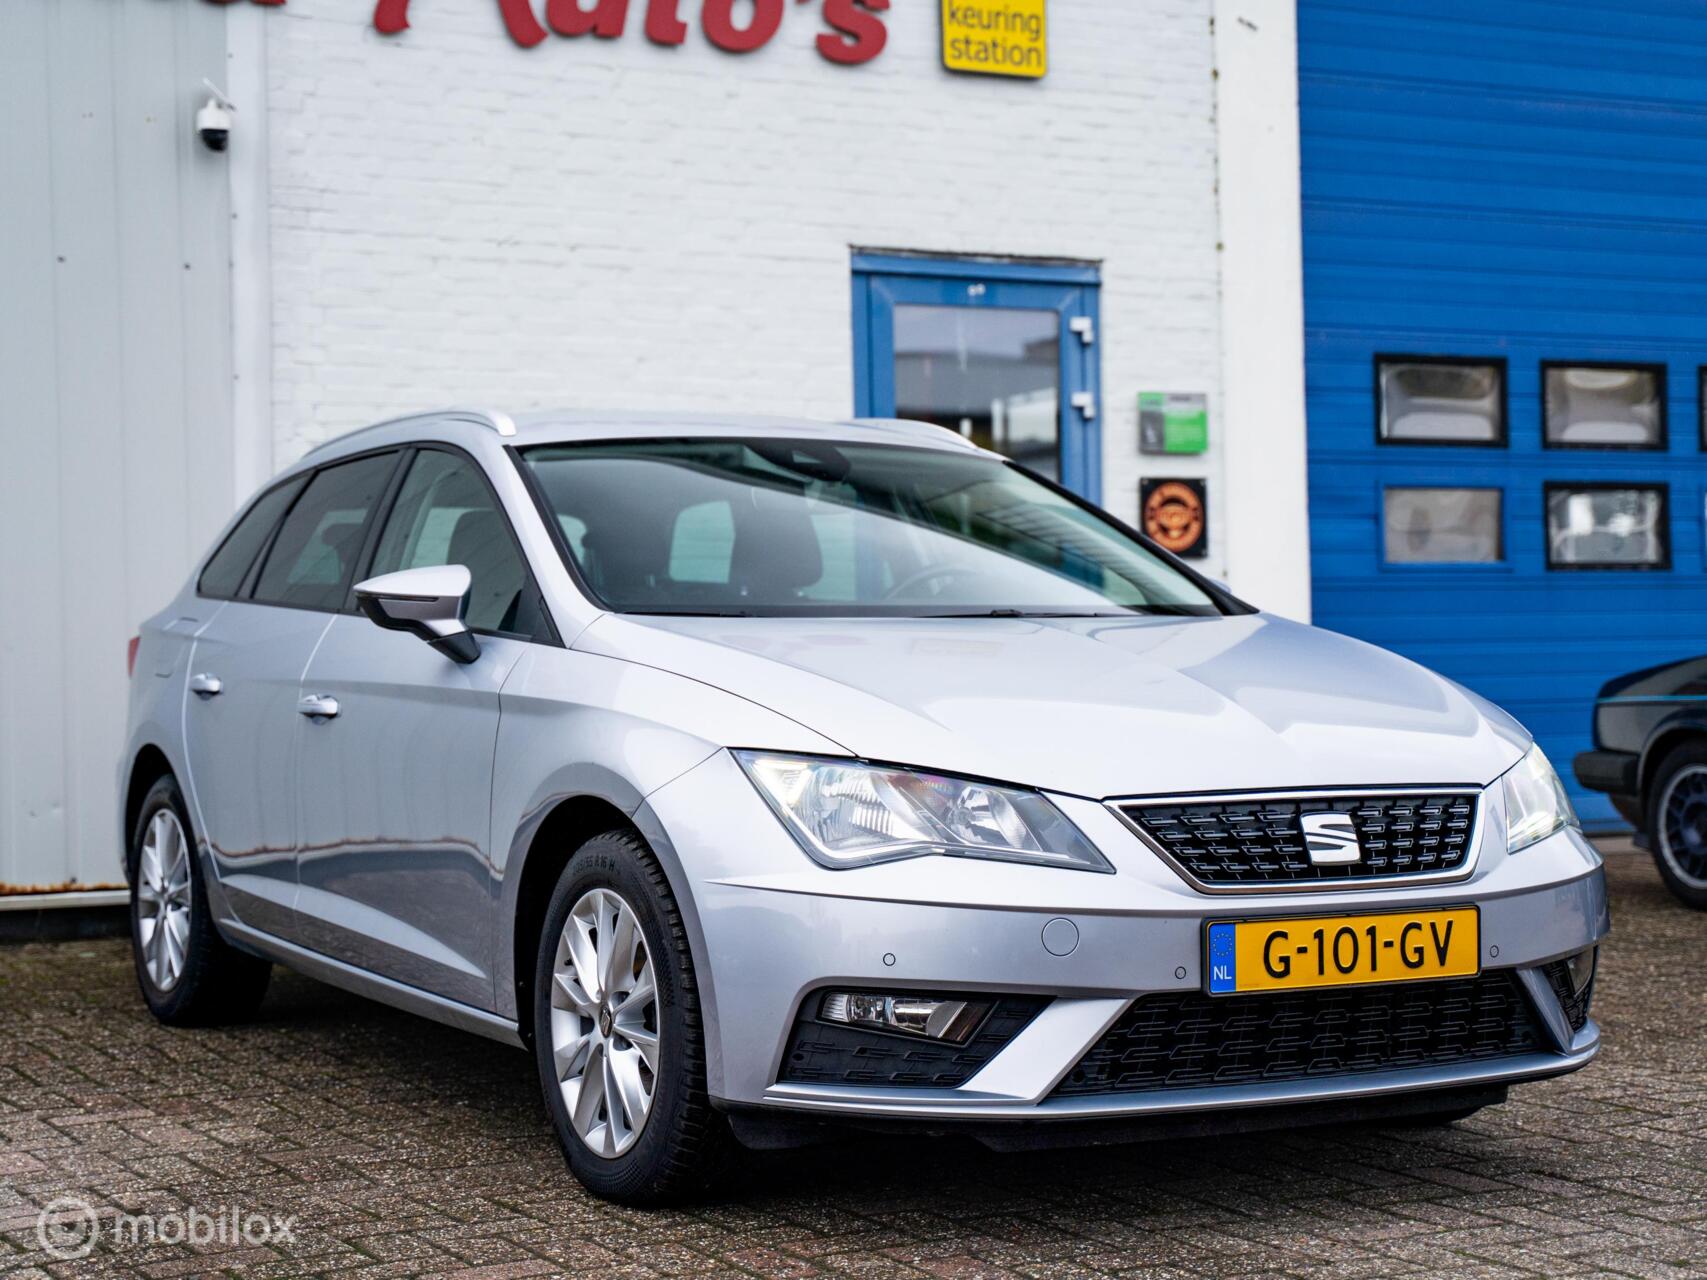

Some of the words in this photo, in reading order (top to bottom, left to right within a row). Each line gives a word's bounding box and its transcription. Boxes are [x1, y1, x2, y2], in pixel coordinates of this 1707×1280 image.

[373, 0, 890, 64] utos
[948, 0, 1041, 42] keuring
[950, 36, 1042, 67] station
[1263, 920, 1453, 979] G-101-GV
[1213, 965, 1232, 981] NL
